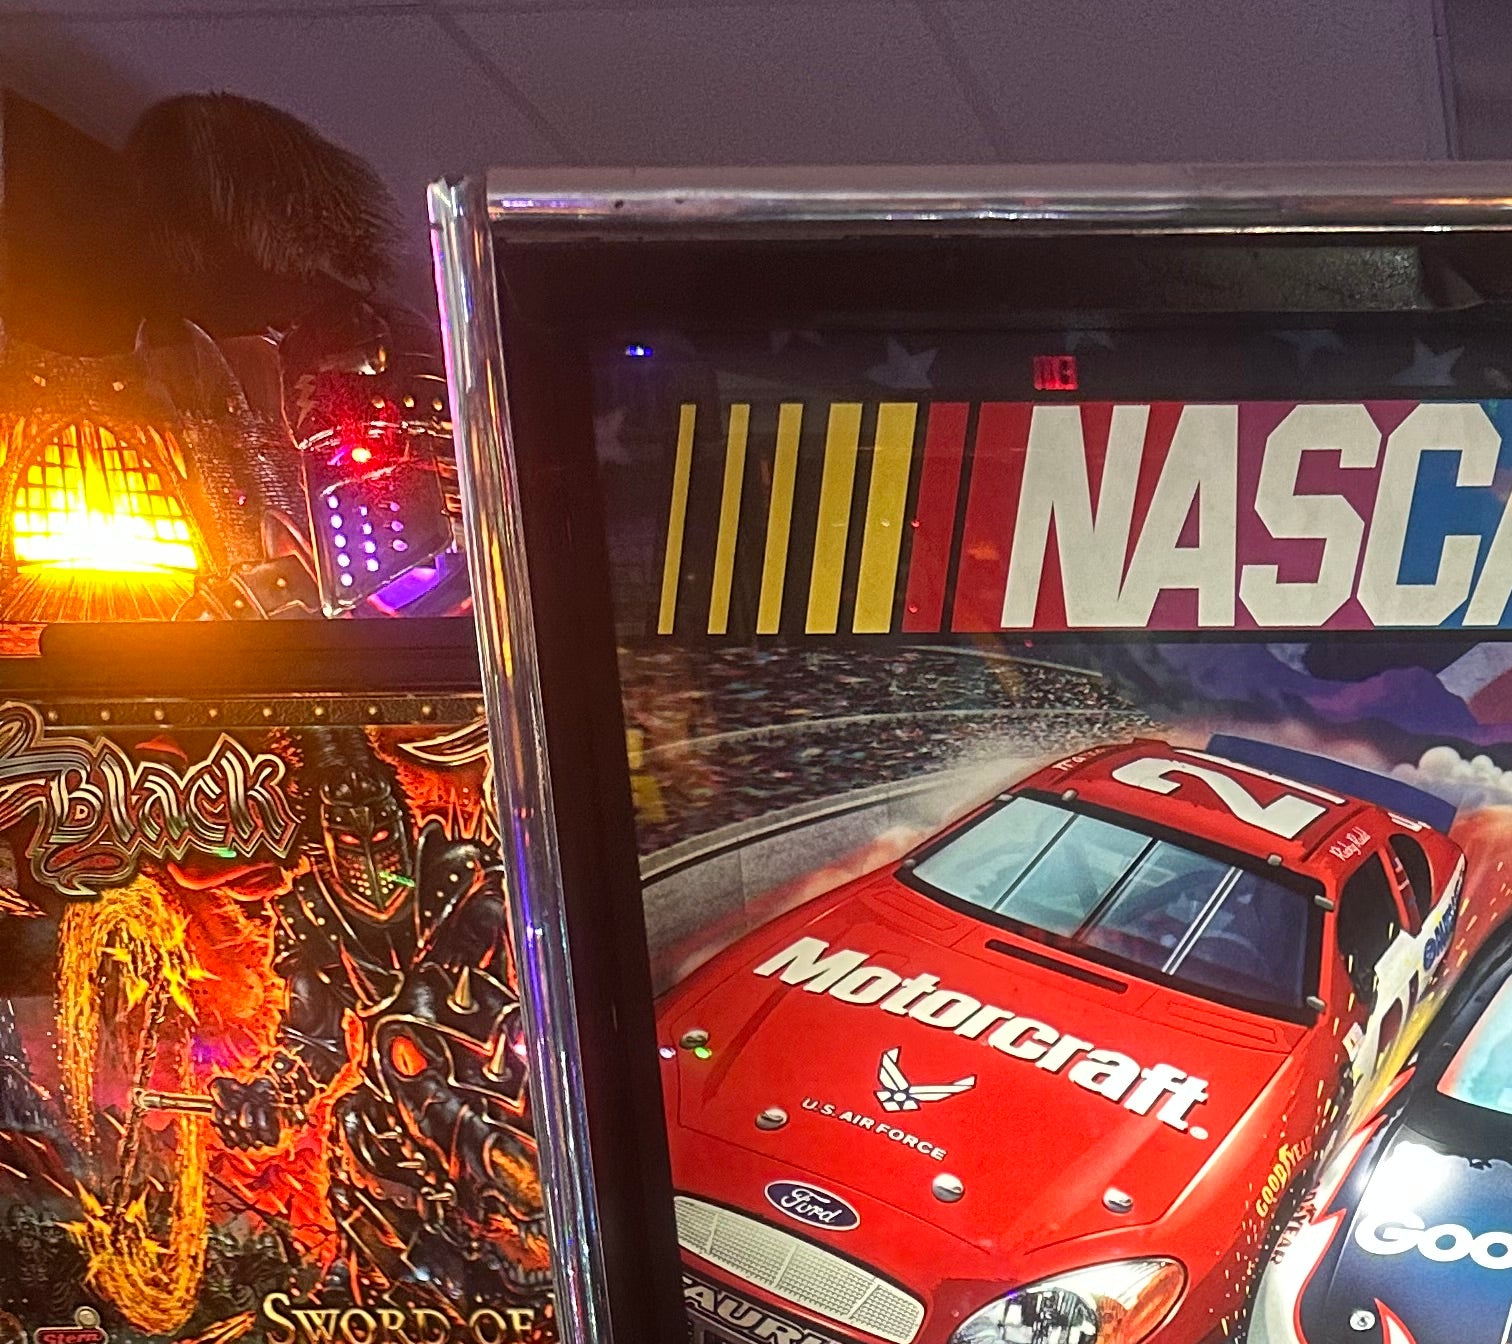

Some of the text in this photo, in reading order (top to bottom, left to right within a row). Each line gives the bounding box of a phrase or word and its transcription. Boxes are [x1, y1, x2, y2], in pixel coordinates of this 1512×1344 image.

[40, 728, 302, 862] Black
[802, 1099, 947, 1163] U.S. AIR FORCE
[780, 1184, 842, 1225] Ford
